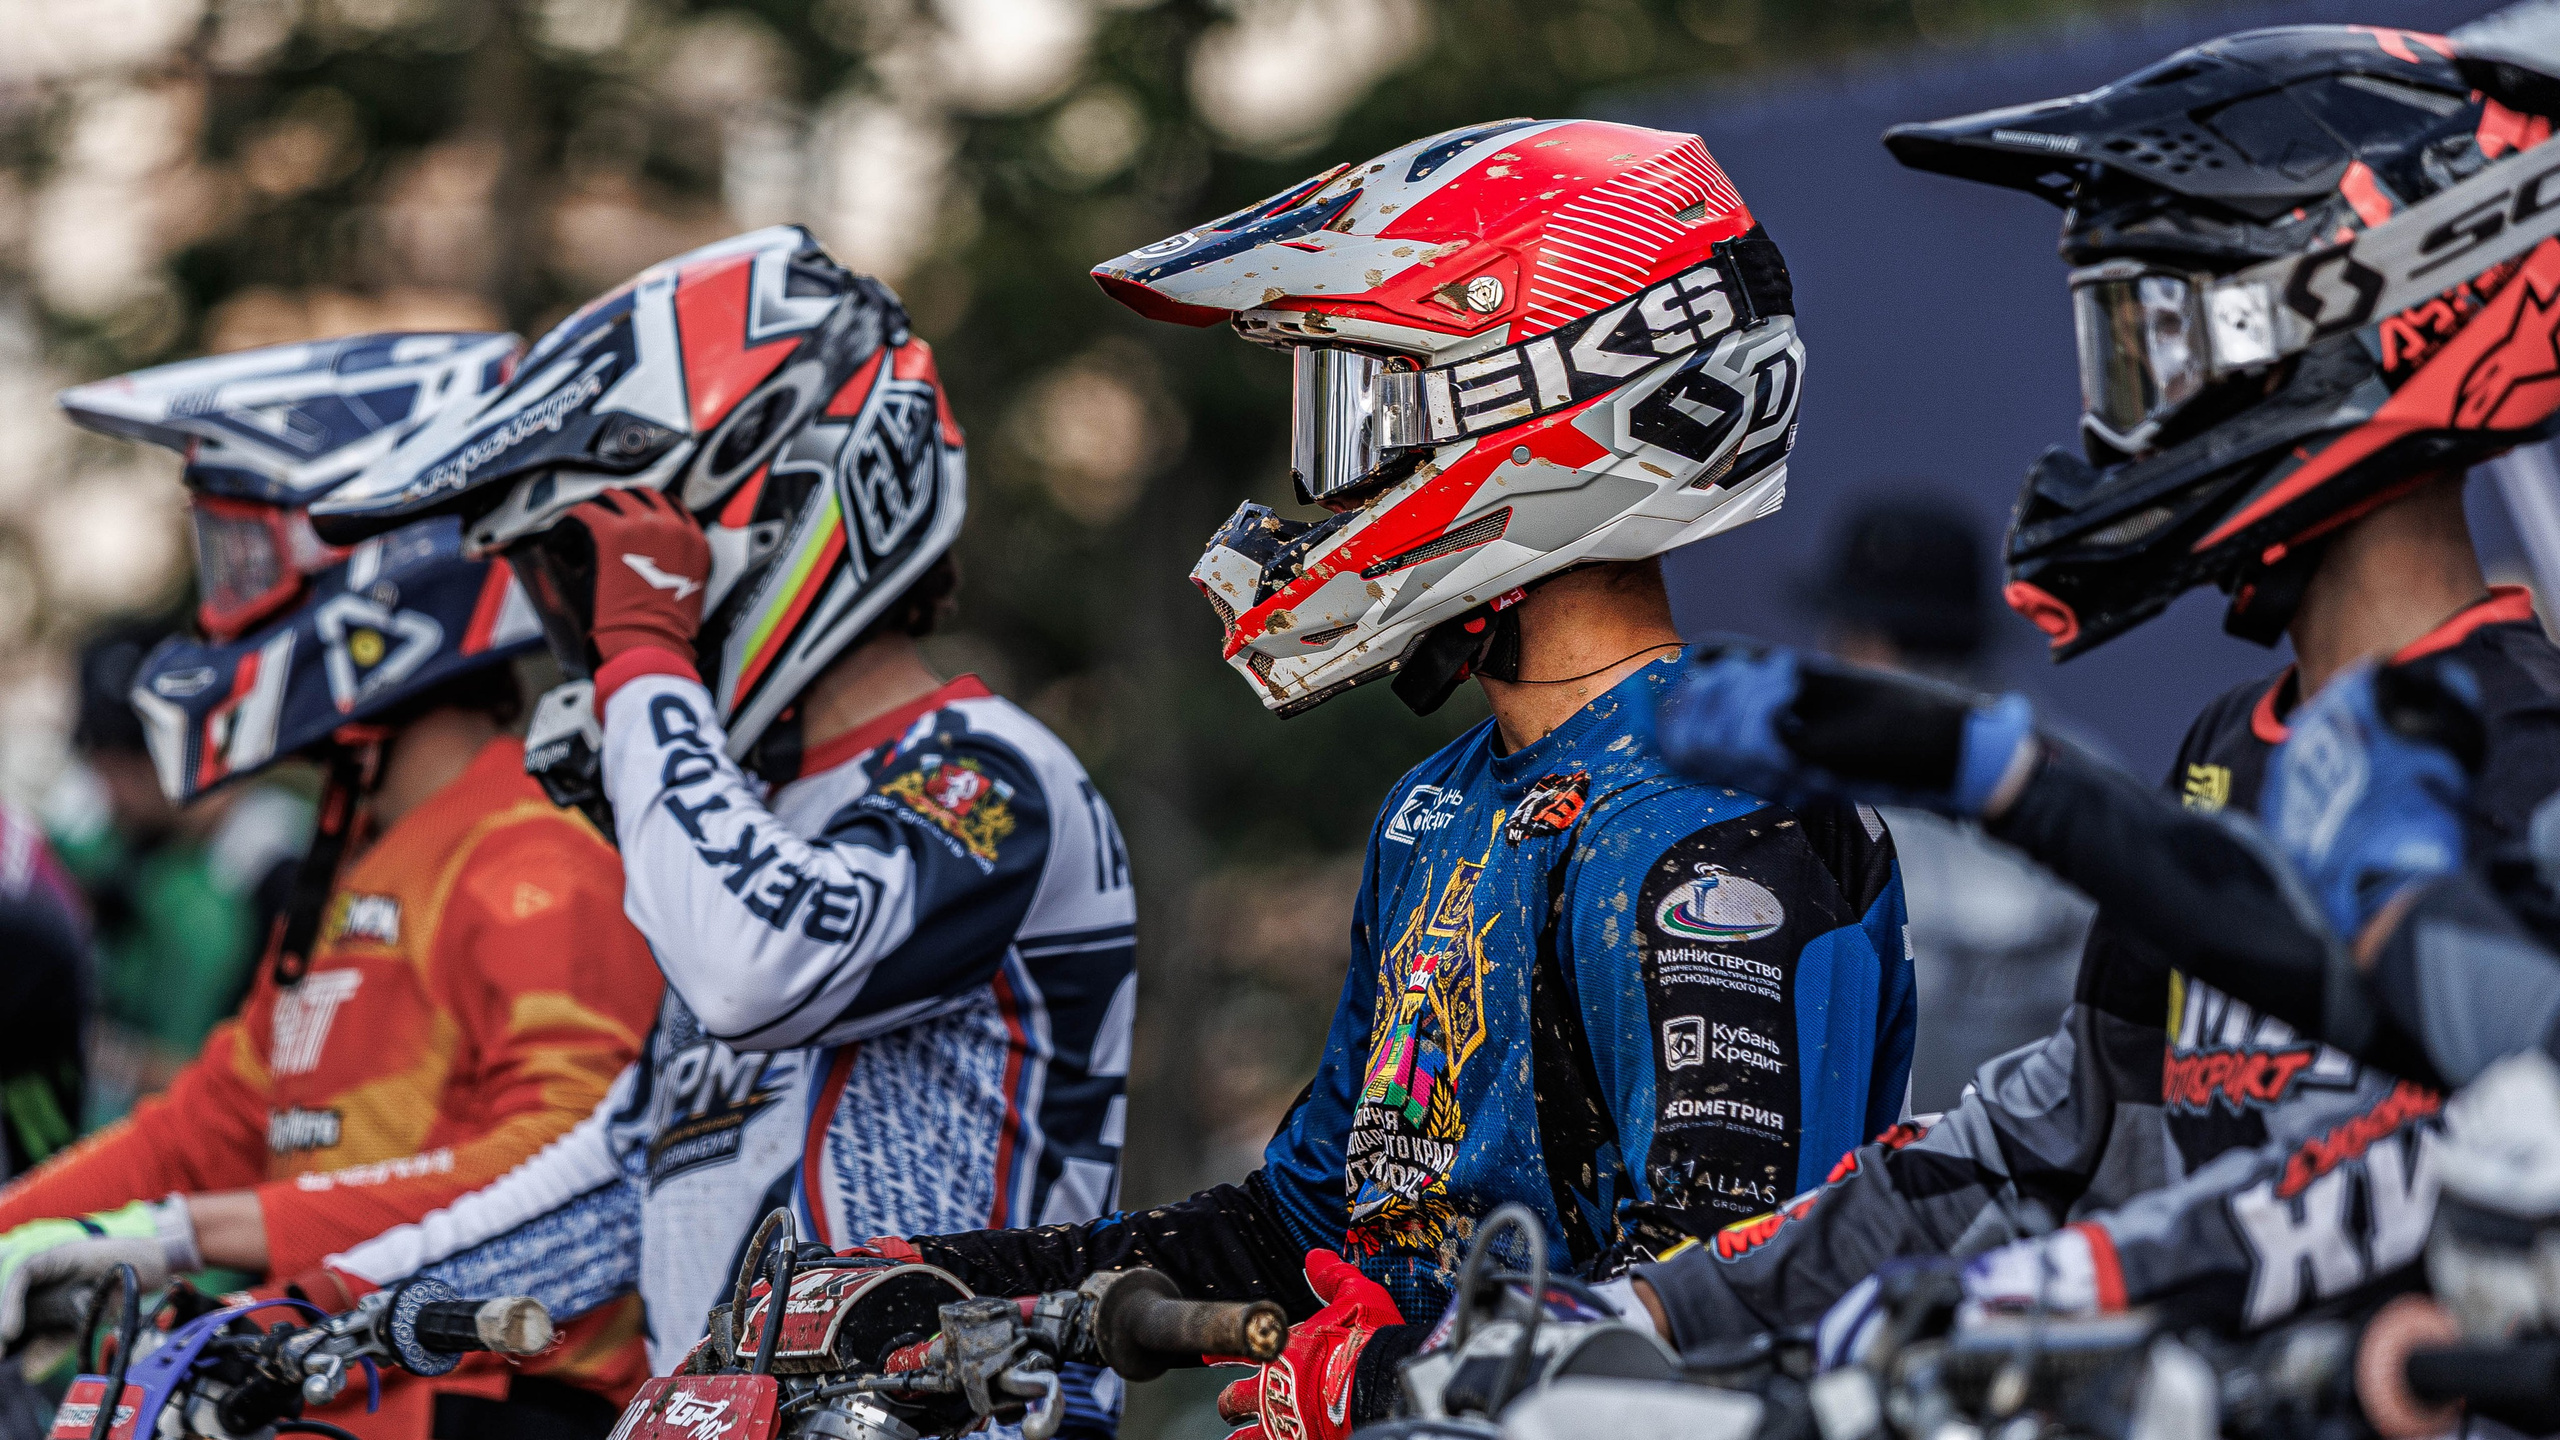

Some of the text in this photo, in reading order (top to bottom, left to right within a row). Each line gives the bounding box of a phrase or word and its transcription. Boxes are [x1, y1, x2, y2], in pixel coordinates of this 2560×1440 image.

[1424, 266, 1736, 441] EKS
[1657, 948, 1782, 980] МИНИСТЕРСТВО
[1660, 973, 1781, 1003] КРАСНОДАРСКОГО КРАЯ
[1712, 1022, 1780, 1055] Кубань
[1711, 1042, 1781, 1074] Кредит
[1712, 1199, 1754, 1213] GROUP
